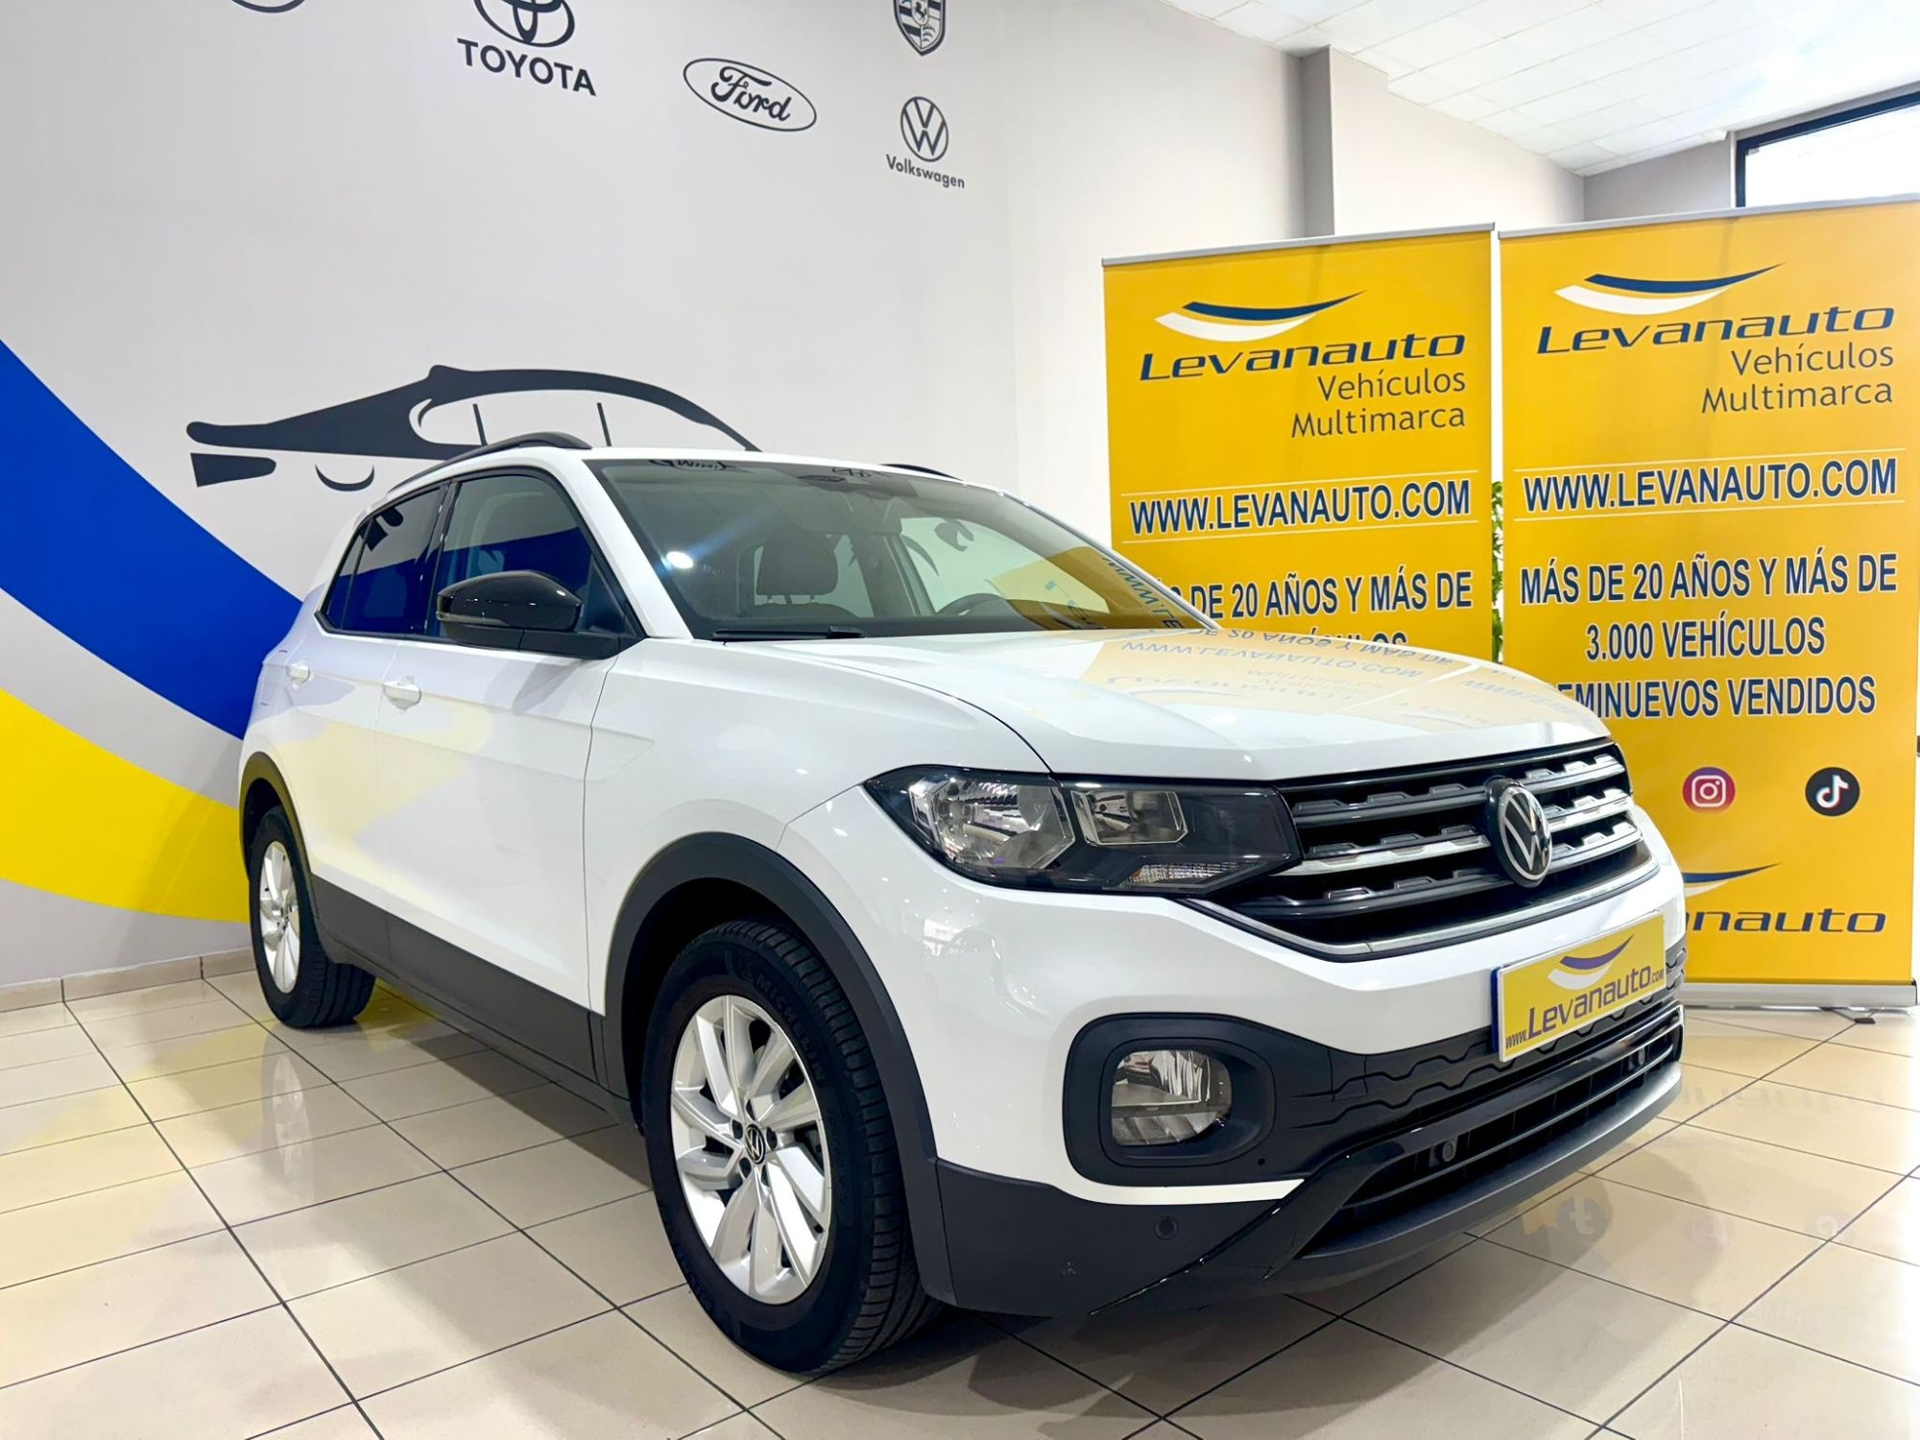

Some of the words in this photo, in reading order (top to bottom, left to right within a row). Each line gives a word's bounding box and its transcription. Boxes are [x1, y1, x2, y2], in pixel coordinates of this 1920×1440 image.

[457, 37, 597, 97] TOYOTA
[710, 65, 792, 123] Ford
[885, 153, 965, 189] Volkswagen
[1537, 306, 1895, 354] Levanauto
[1140, 333, 1466, 382] Levanauto
[1731, 341, 1894, 376] Vehículos
[1317, 368, 1466, 402] Vehículos
[1701, 382, 1893, 414] Multimarca
[1290, 406, 1465, 439] Multimarca
[1130, 479, 1470, 534] WWW.LEVANAUTO.COM
[1524, 458, 1897, 512] WWW.LEVANAUTO.COM
[1232, 583, 1258, 618] 20
[1265, 573, 1338, 617] AÑOS
[1345, 577, 1363, 612] Y
[1371, 566, 1428, 611] MÁS
[1437, 571, 1473, 608] DE
[1521, 558, 1579, 605] MÁS
[1589, 564, 1624, 602] DE
[1633, 563, 1663, 600] 20
[1670, 553, 1750, 599] AÑOS
[1759, 558, 1778, 595] Y
[1786, 547, 1849, 594] MÁS
[1859, 553, 1897, 592] DE
[1586, 623, 1654, 660] 3.000
[1662, 611, 1826, 657] VEHÍCULOS
[1557, 679, 1719, 718] MINUEVOS
[1728, 676, 1876, 716] VENDIDOS
